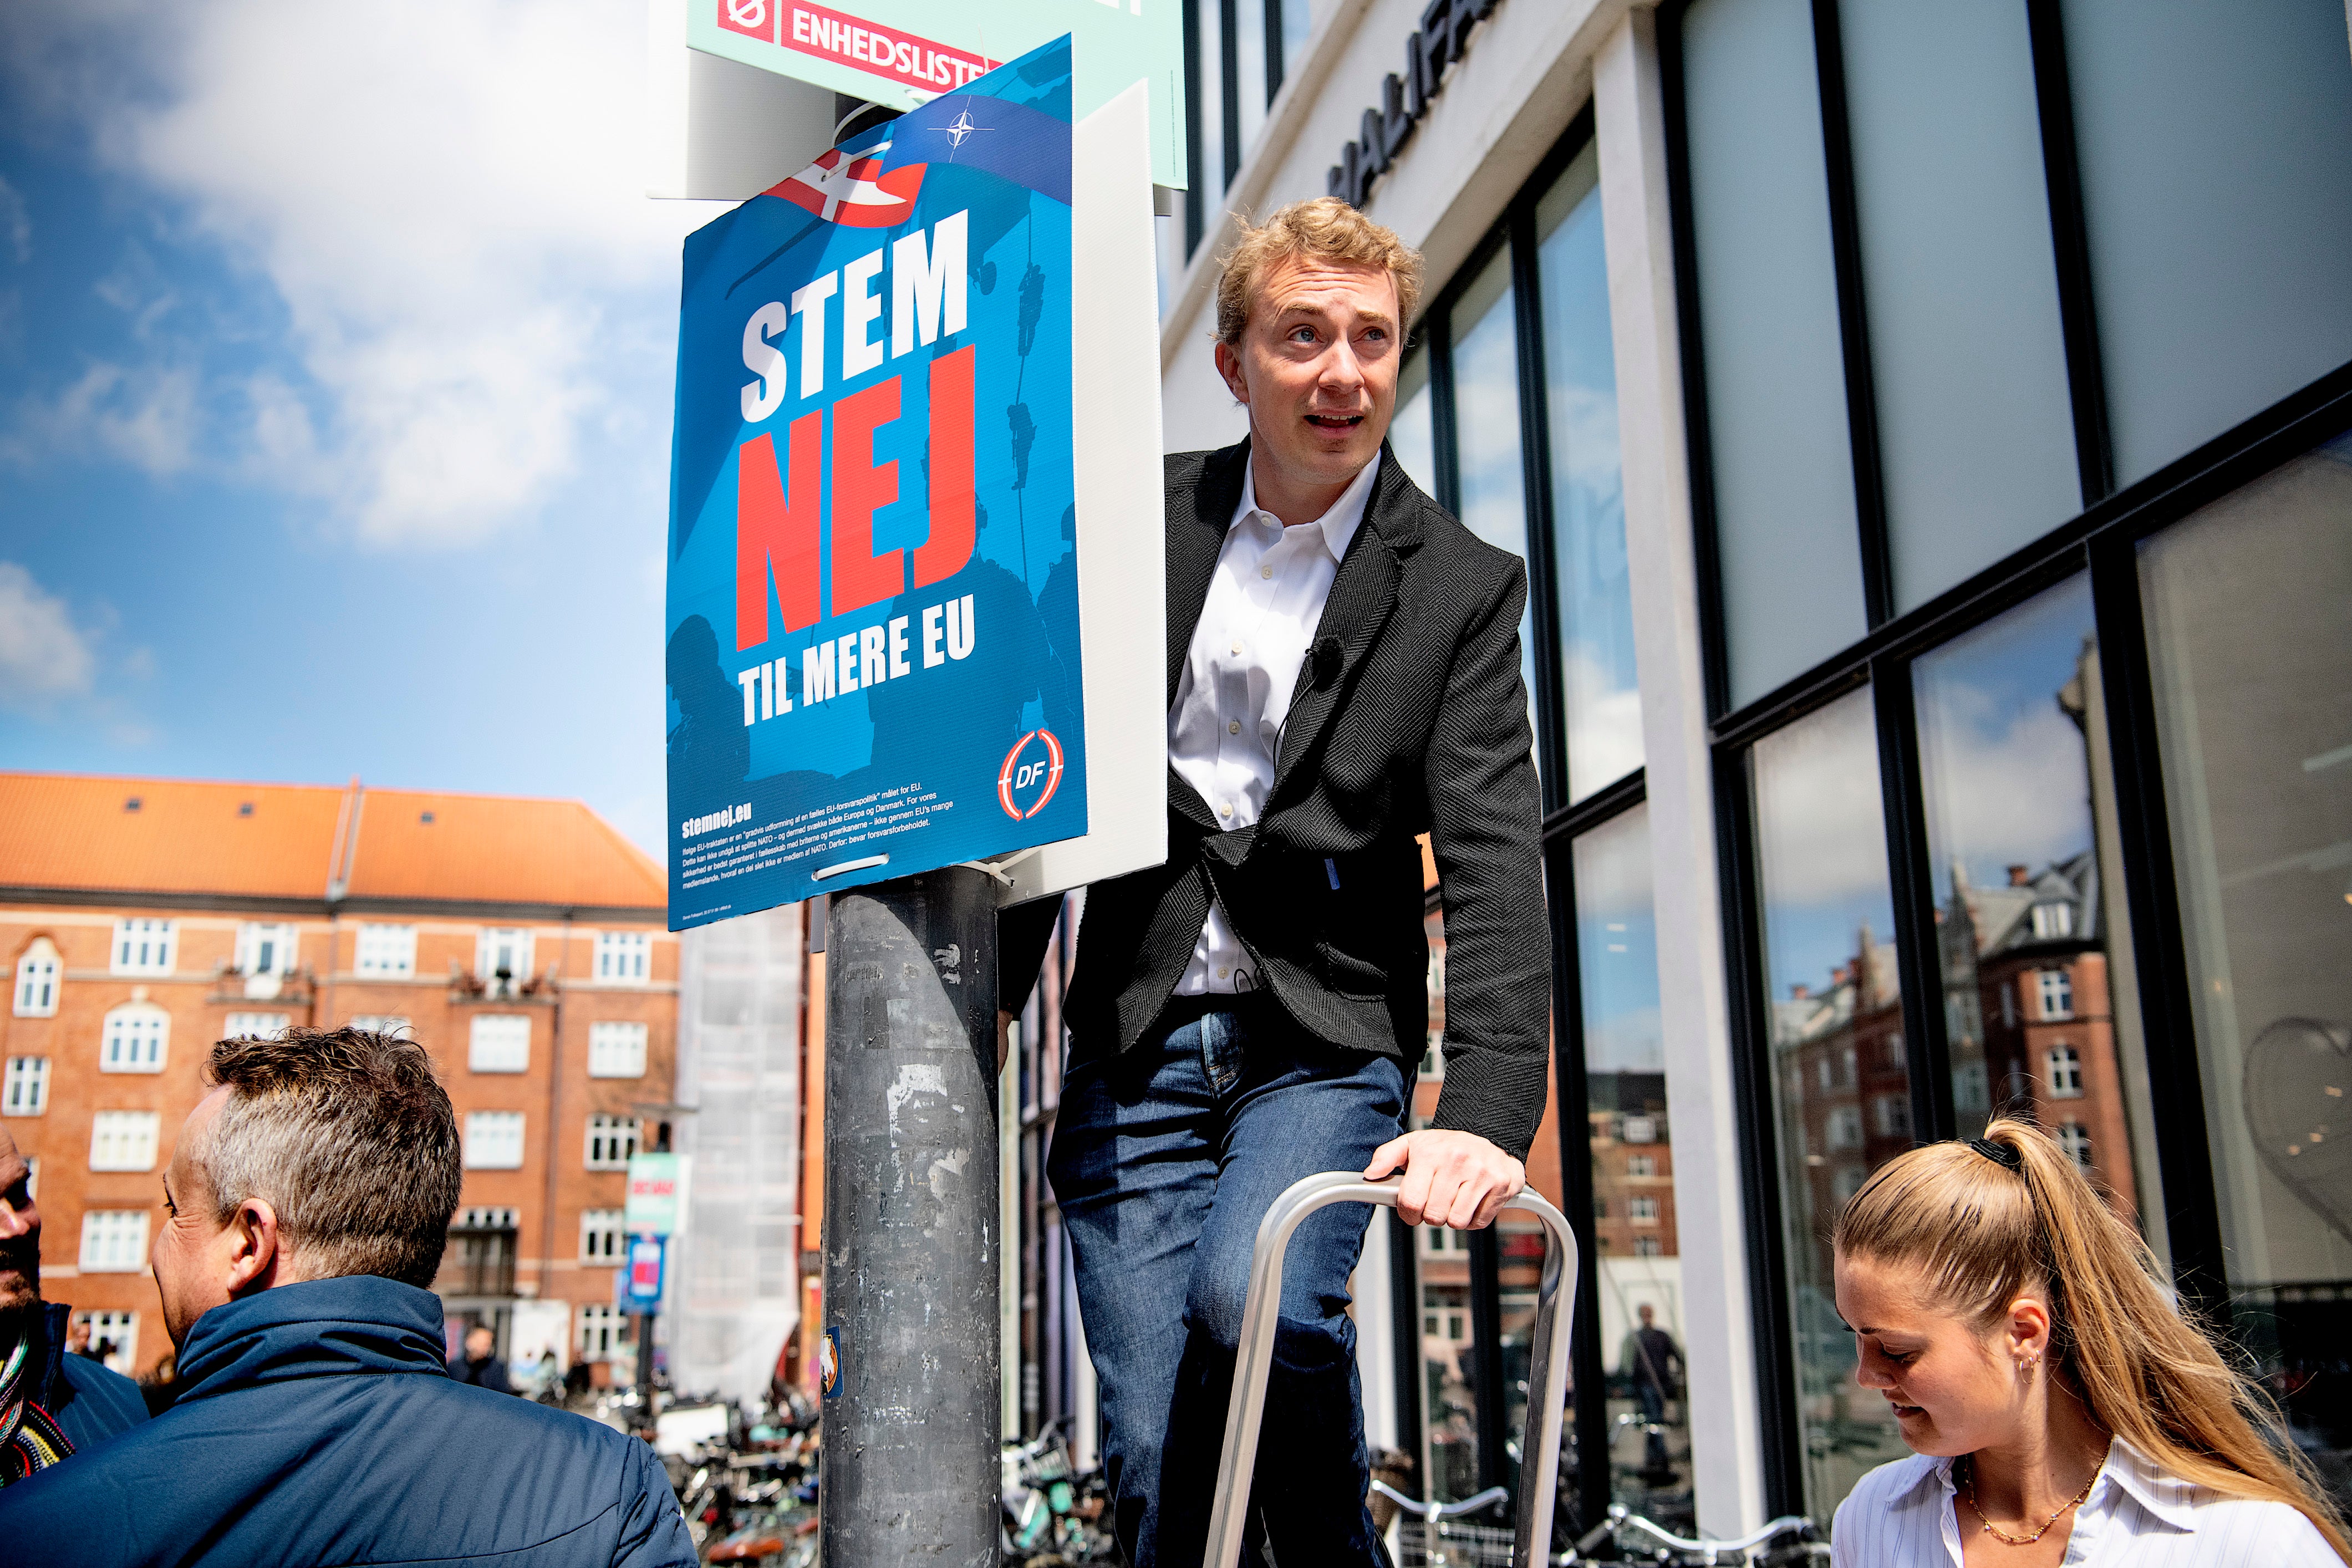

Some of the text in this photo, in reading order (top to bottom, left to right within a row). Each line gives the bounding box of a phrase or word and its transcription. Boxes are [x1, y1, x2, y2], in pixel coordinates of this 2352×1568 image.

[793, 8, 990, 89] ENHEDSLISTE
[741, 208, 968, 422] STEM
[736, 343, 976, 652] NEJ
[738, 593, 975, 727] TIL MERE EU
[1015, 761, 1046, 789] DF
[683, 803, 751, 838] stemnej.eu
[683, 858, 696, 867] Dette
[719, 846, 734, 857] undgå
[741, 841, 757, 851] splitte
[758, 835, 773, 846] NATO
[786, 825, 806, 837] dermed
[807, 820, 827, 831] svække
[828, 816, 842, 825] både
[844, 810, 864, 821] Europa
[876, 800, 905, 812] Danmark.
[907, 797, 918, 805] For
[919, 793, 936, 802] vores
[683, 866, 706, 878] sikkerhed
[714, 860, 727, 869] bedst
[729, 852, 755, 867] garanteret
[758, 844, 786, 857] fællesskab
[787, 839, 798, 849] med
[800, 835, 819, 846] briterne
[829, 822, 867, 837] amerikanerne
[874, 817, 887, 825] ikke
[889, 811, 913, 823] gennem
[931, 801, 953, 812] mange
[683, 874, 720, 889] medlemslande,
[721, 868, 737, 879] hvoraf
[745, 864, 754, 872] del
[755, 862, 764, 870] slet
[783, 852, 804, 862] medlem
[805, 848, 810, 856] af
[811, 843, 827, 854] NATO.
[829, 839, 847, 849] Derfor:
[849, 834, 866, 843] bevar
[868, 818, 930, 839] forsvarsforbeholdet.
[698, 838, 728, 852] EU-traktaten
[765, 818, 793, 832] udformning
[795, 814, 800, 823] af
[809, 809, 825, 818] fælles
[882, 788, 899, 798] målet
[911, 782, 922, 792] EU.
